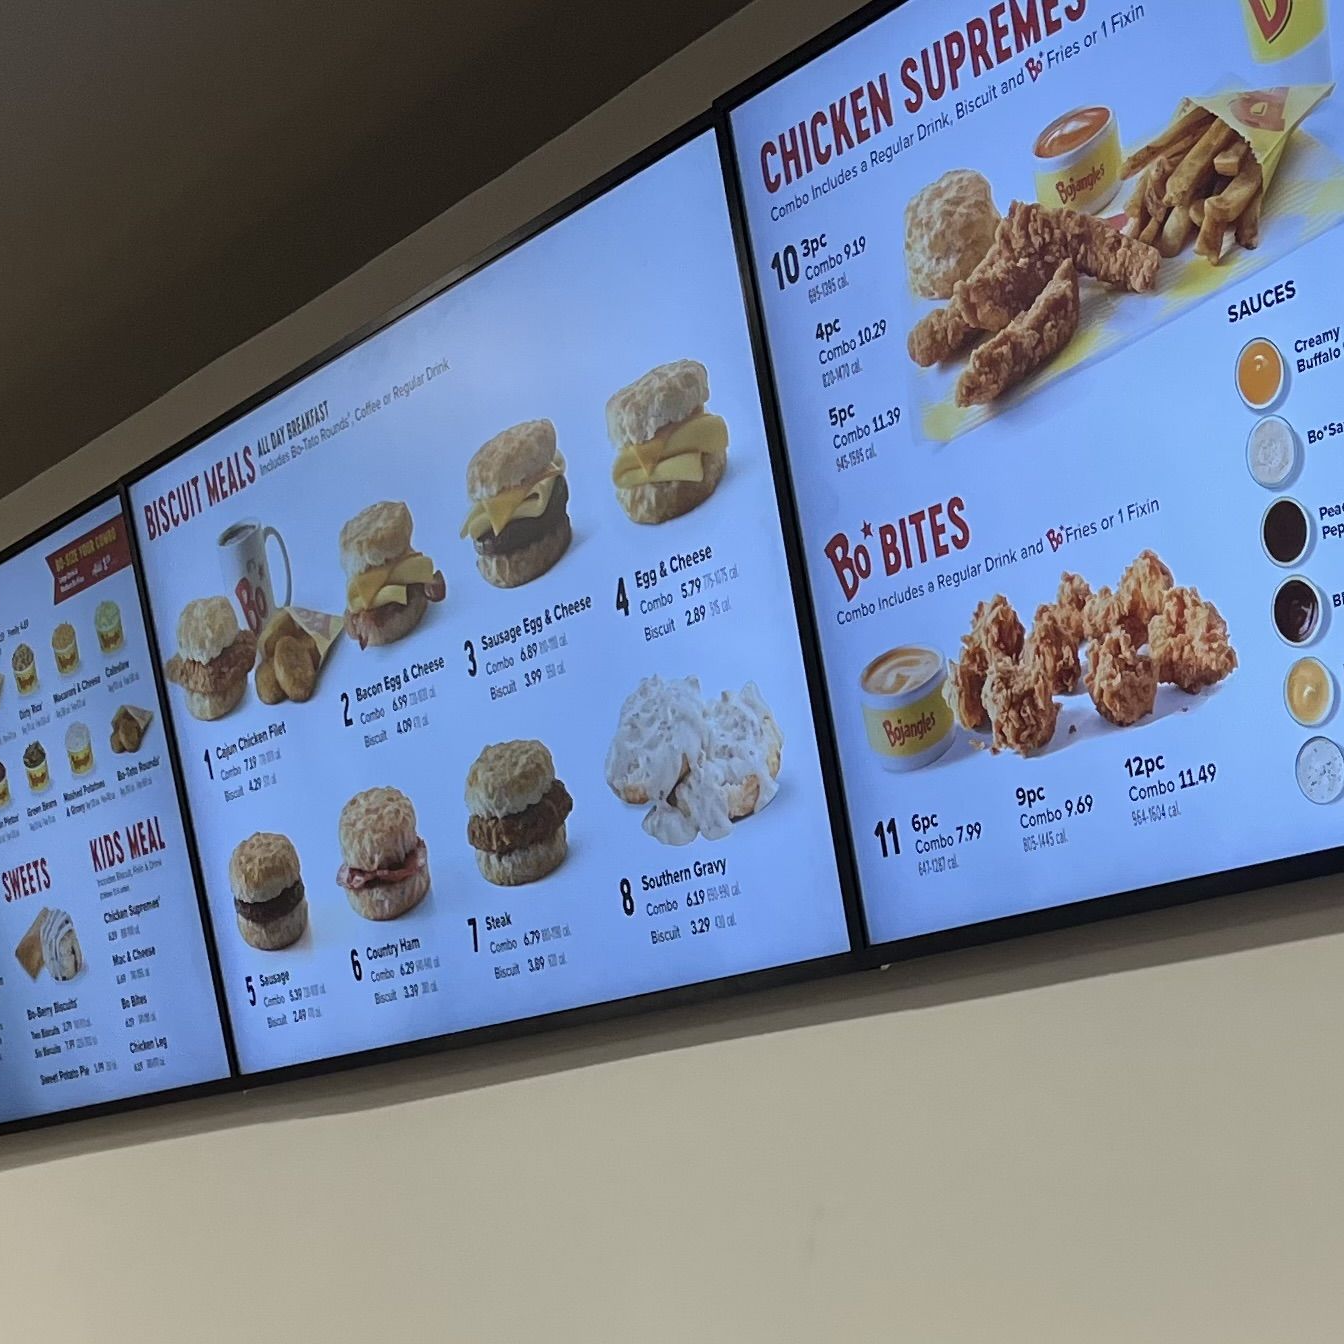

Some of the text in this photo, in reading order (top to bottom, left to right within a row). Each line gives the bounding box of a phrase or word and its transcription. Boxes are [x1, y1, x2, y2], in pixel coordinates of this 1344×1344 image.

[771, 4, 1145, 221] Combo Includes Regular Biscuit and Fries or Fixin
[760, 73, 893, 194] CHICKEN
[771, 245, 799, 291] 10
[806, 252, 842, 280] Combo
[1228, 280, 1296, 323] SAUCES
[819, 338, 856, 364] Combo
[1294, 327, 1340, 353] Creamy
[1297, 348, 1341, 373] Buffalo
[287, 401, 330, 439] BREAKFAST
[833, 423, 870, 448] Combo
[144, 445, 256, 541] BISCUIT MEALS
[879, 496, 970, 576] BITES
[837, 499, 1160, 625] Combo Includes Regular Drink and Fries Fixin
[616, 546, 712, 617] 4 Egg Cheese
[640, 592, 674, 614] Combo
[464, 640, 477, 678] 3
[481, 625, 522, 650] Sausage
[523, 614, 543, 635] Egg
[554, 596, 592, 621] Cheese
[644, 618, 676, 642] Biscuit
[486, 654, 514, 676] Combo
[341, 692, 353, 727] 2
[355, 681, 382, 702] Bacon
[384, 674, 401, 691] Egg
[411, 656, 445, 681] Cheese
[490, 680, 517, 700] Biscuit
[882, 711, 936, 748] Bojangles
[204, 730, 268, 780] 1 Chicken
[1125, 756, 1165, 778] 12pc
[1129, 763, 1216, 801] Combo 11.49
[1020, 808, 1062, 828] Combo
[89, 817, 166, 872] KIDS MEAL
[874, 818, 900, 858] 11
[915, 834, 954, 854] Combo
[2, 857, 51, 902] SWEETS
[620, 858, 726, 916] 8 Southern Gravy
[485, 912, 512, 930] Steak
[646, 900, 678, 916] Combo
[490, 939, 517, 953] Combo
[651, 926, 681, 944] Biscuit
[351, 937, 420, 981] 6 Country Ham
[245, 976, 256, 1006] 5
